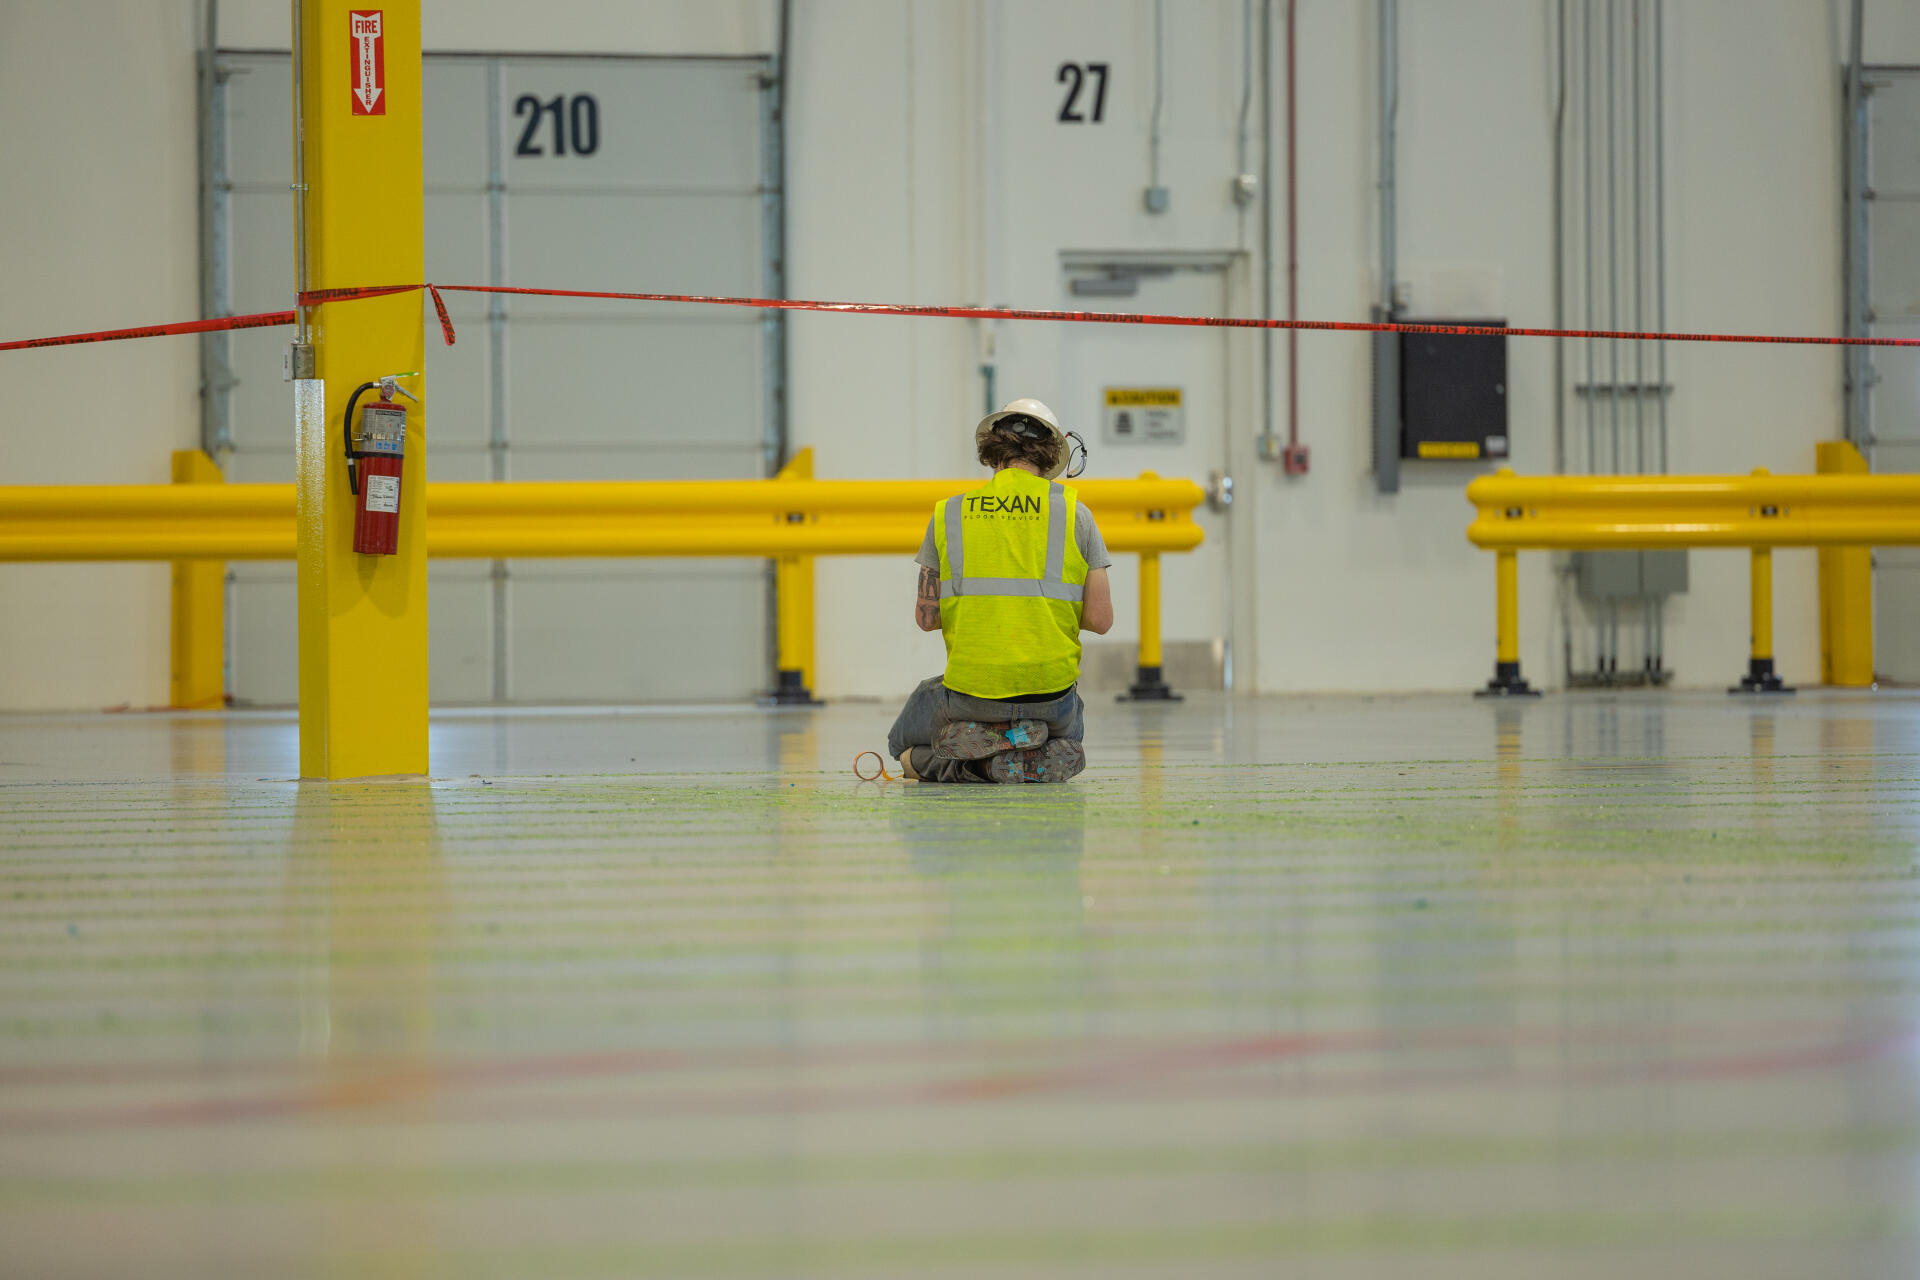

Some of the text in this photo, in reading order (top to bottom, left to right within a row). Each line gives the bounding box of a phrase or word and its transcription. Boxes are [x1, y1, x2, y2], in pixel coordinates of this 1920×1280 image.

[355, 20, 378, 34] FIRE
[364, 36, 372, 106] EXTINGUISHER
[1058, 63, 1108, 123] 27
[515, 95, 599, 157] 210
[966, 495, 1040, 513] TEXAN
